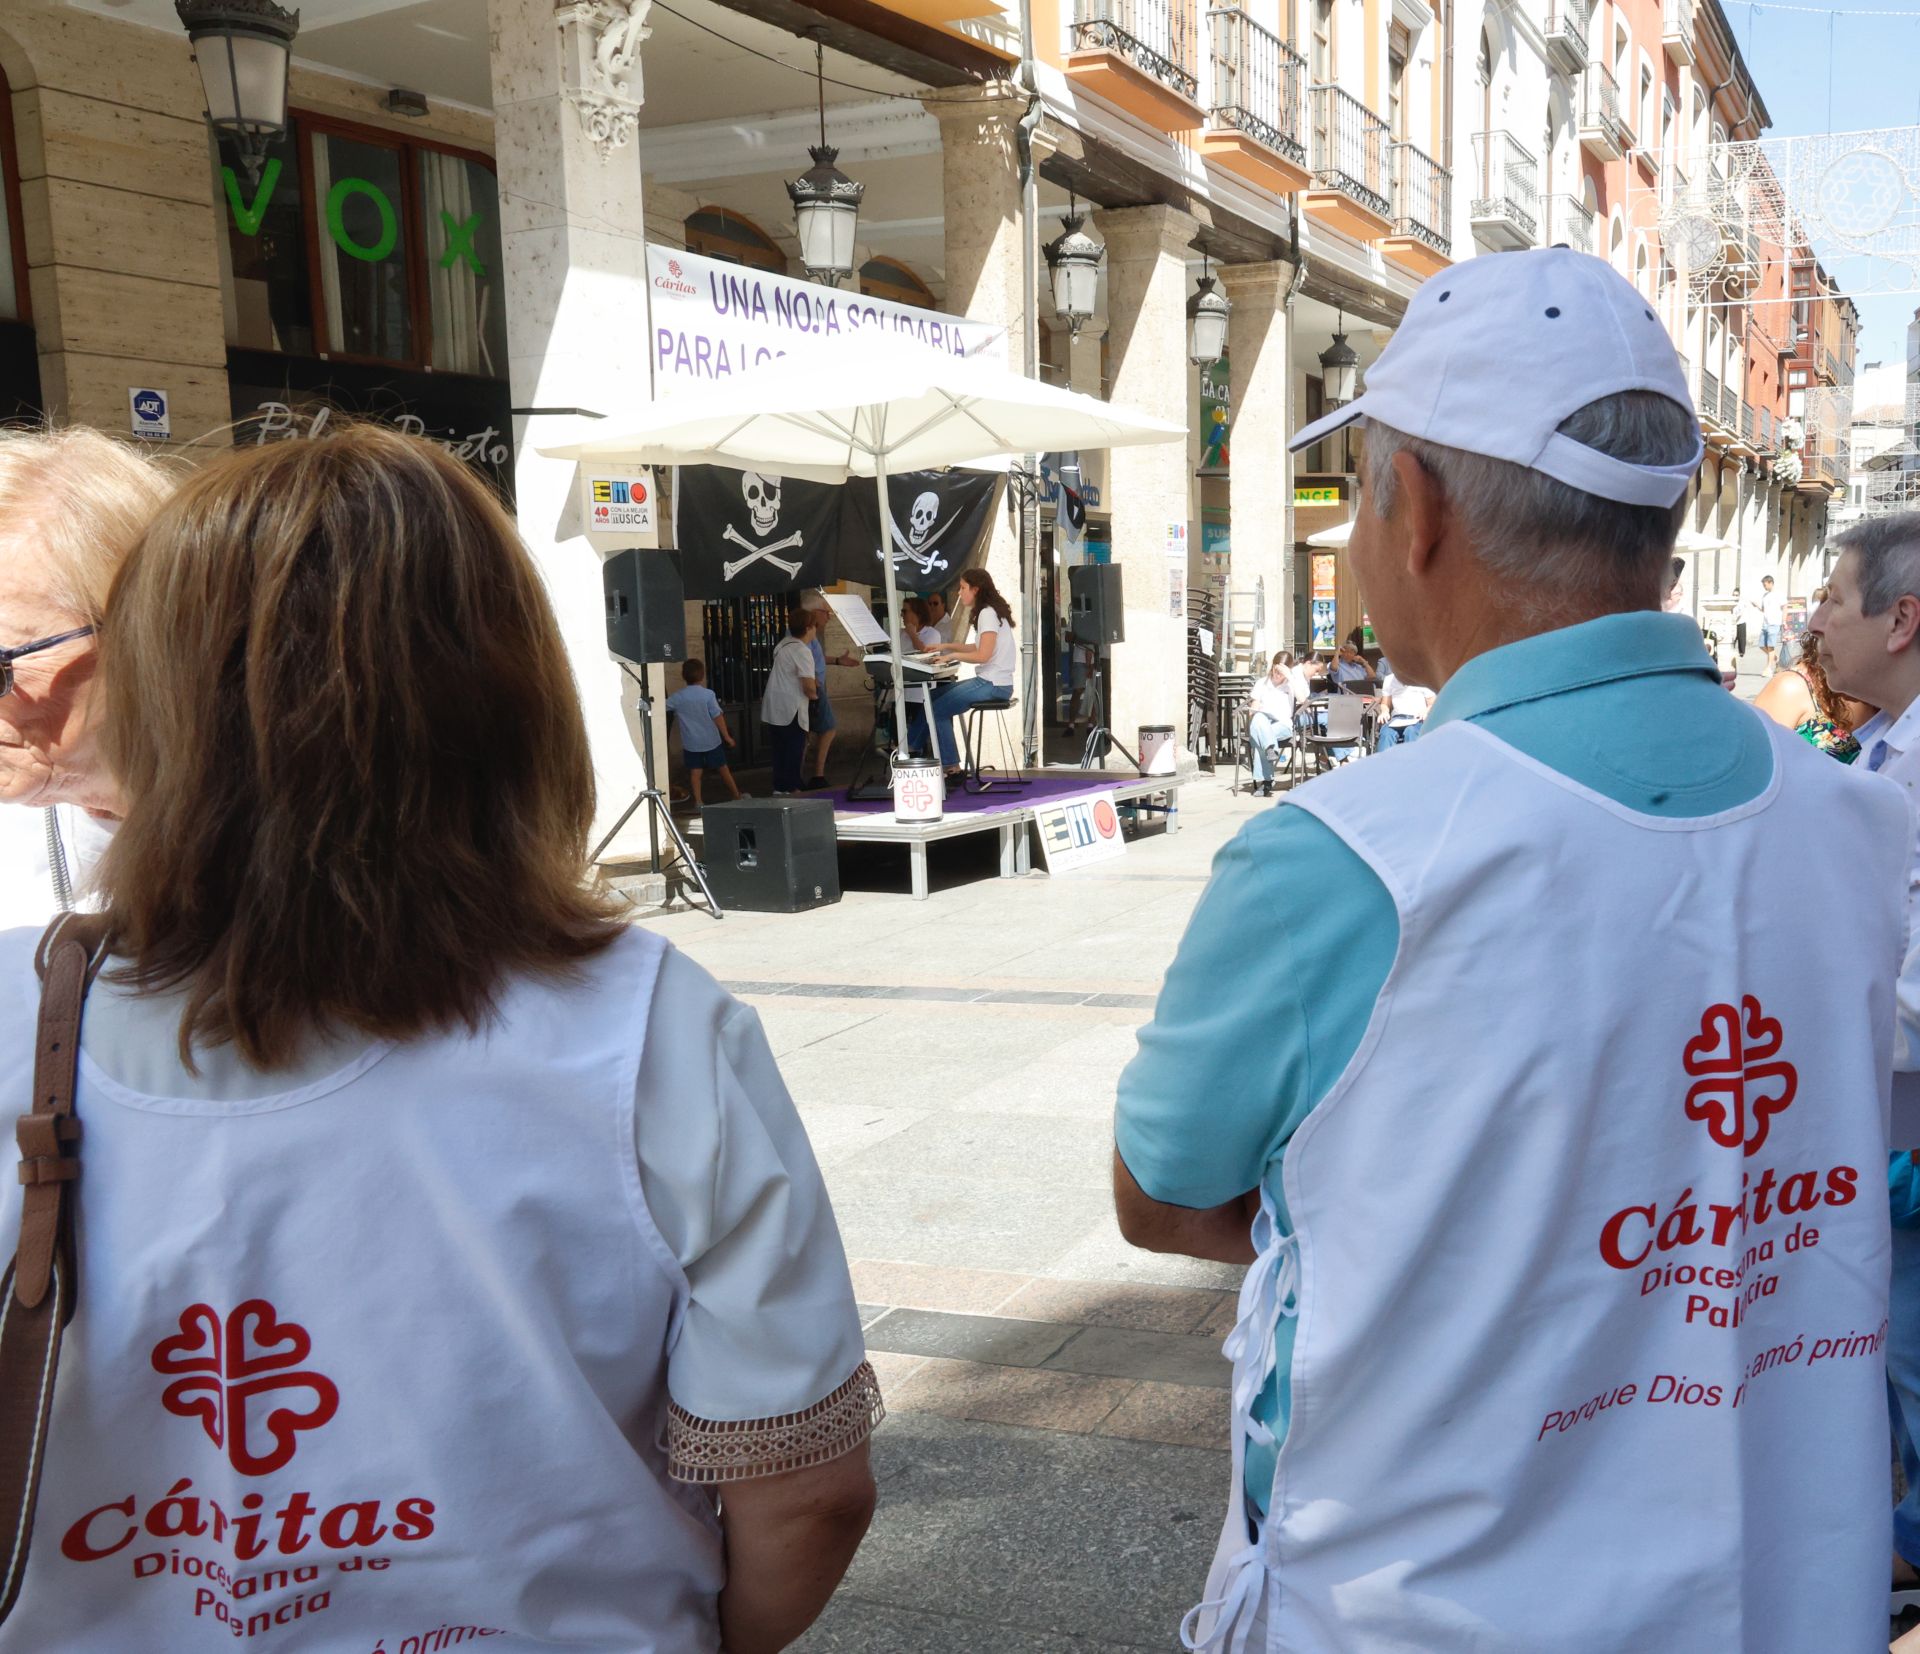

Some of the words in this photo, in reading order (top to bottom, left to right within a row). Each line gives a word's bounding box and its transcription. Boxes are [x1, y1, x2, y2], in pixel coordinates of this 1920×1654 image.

[221, 158, 486, 276] VOX
[654, 276, 697, 295] Cáritas
[709, 270, 769, 324] UNA
[657, 328, 732, 380] PARA
[139, 400, 160, 412] ADT
[394, 414, 508, 465] Pieto
[1599, 1165, 1858, 1269] Cáritas
[1784, 1222, 1819, 1253] de
[1537, 1383, 1637, 1442] Porque
[1647, 1375, 1723, 1407] Dios
[1752, 1334, 1804, 1378] amó
[61, 1478, 436, 1561] Cáritas
[338, 1556, 391, 1572] de
[194, 1588, 331, 1637] Paencia
